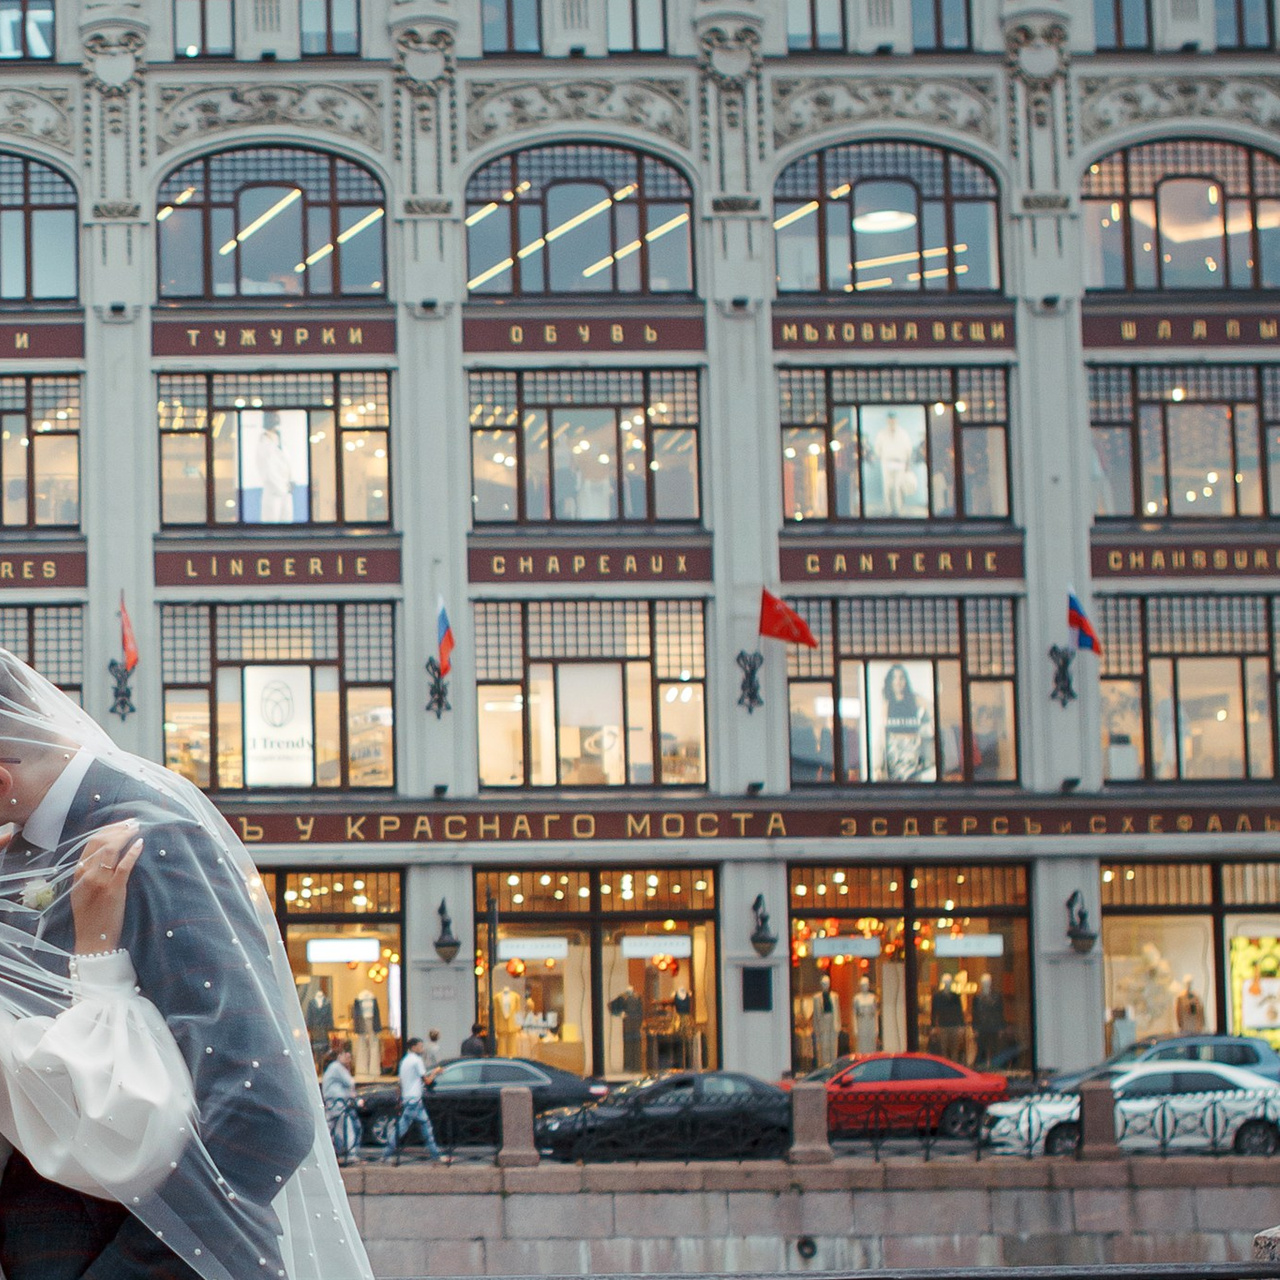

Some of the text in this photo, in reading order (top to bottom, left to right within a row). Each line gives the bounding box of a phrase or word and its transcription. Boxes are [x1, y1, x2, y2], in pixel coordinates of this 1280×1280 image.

[187, 328, 364, 347] ТУЖУРКИ
[510, 325, 658, 343] ОБУВЬ
[932, 322, 1006, 342] ВЕЩИ
[186, 556, 368, 577] LINGERIE
[492, 555, 687, 574] CHAPEAUX
[1108, 549, 1280, 571] CHAUSSUR
[296, 812, 787, 841] У КРАСНАГО МОСТА
